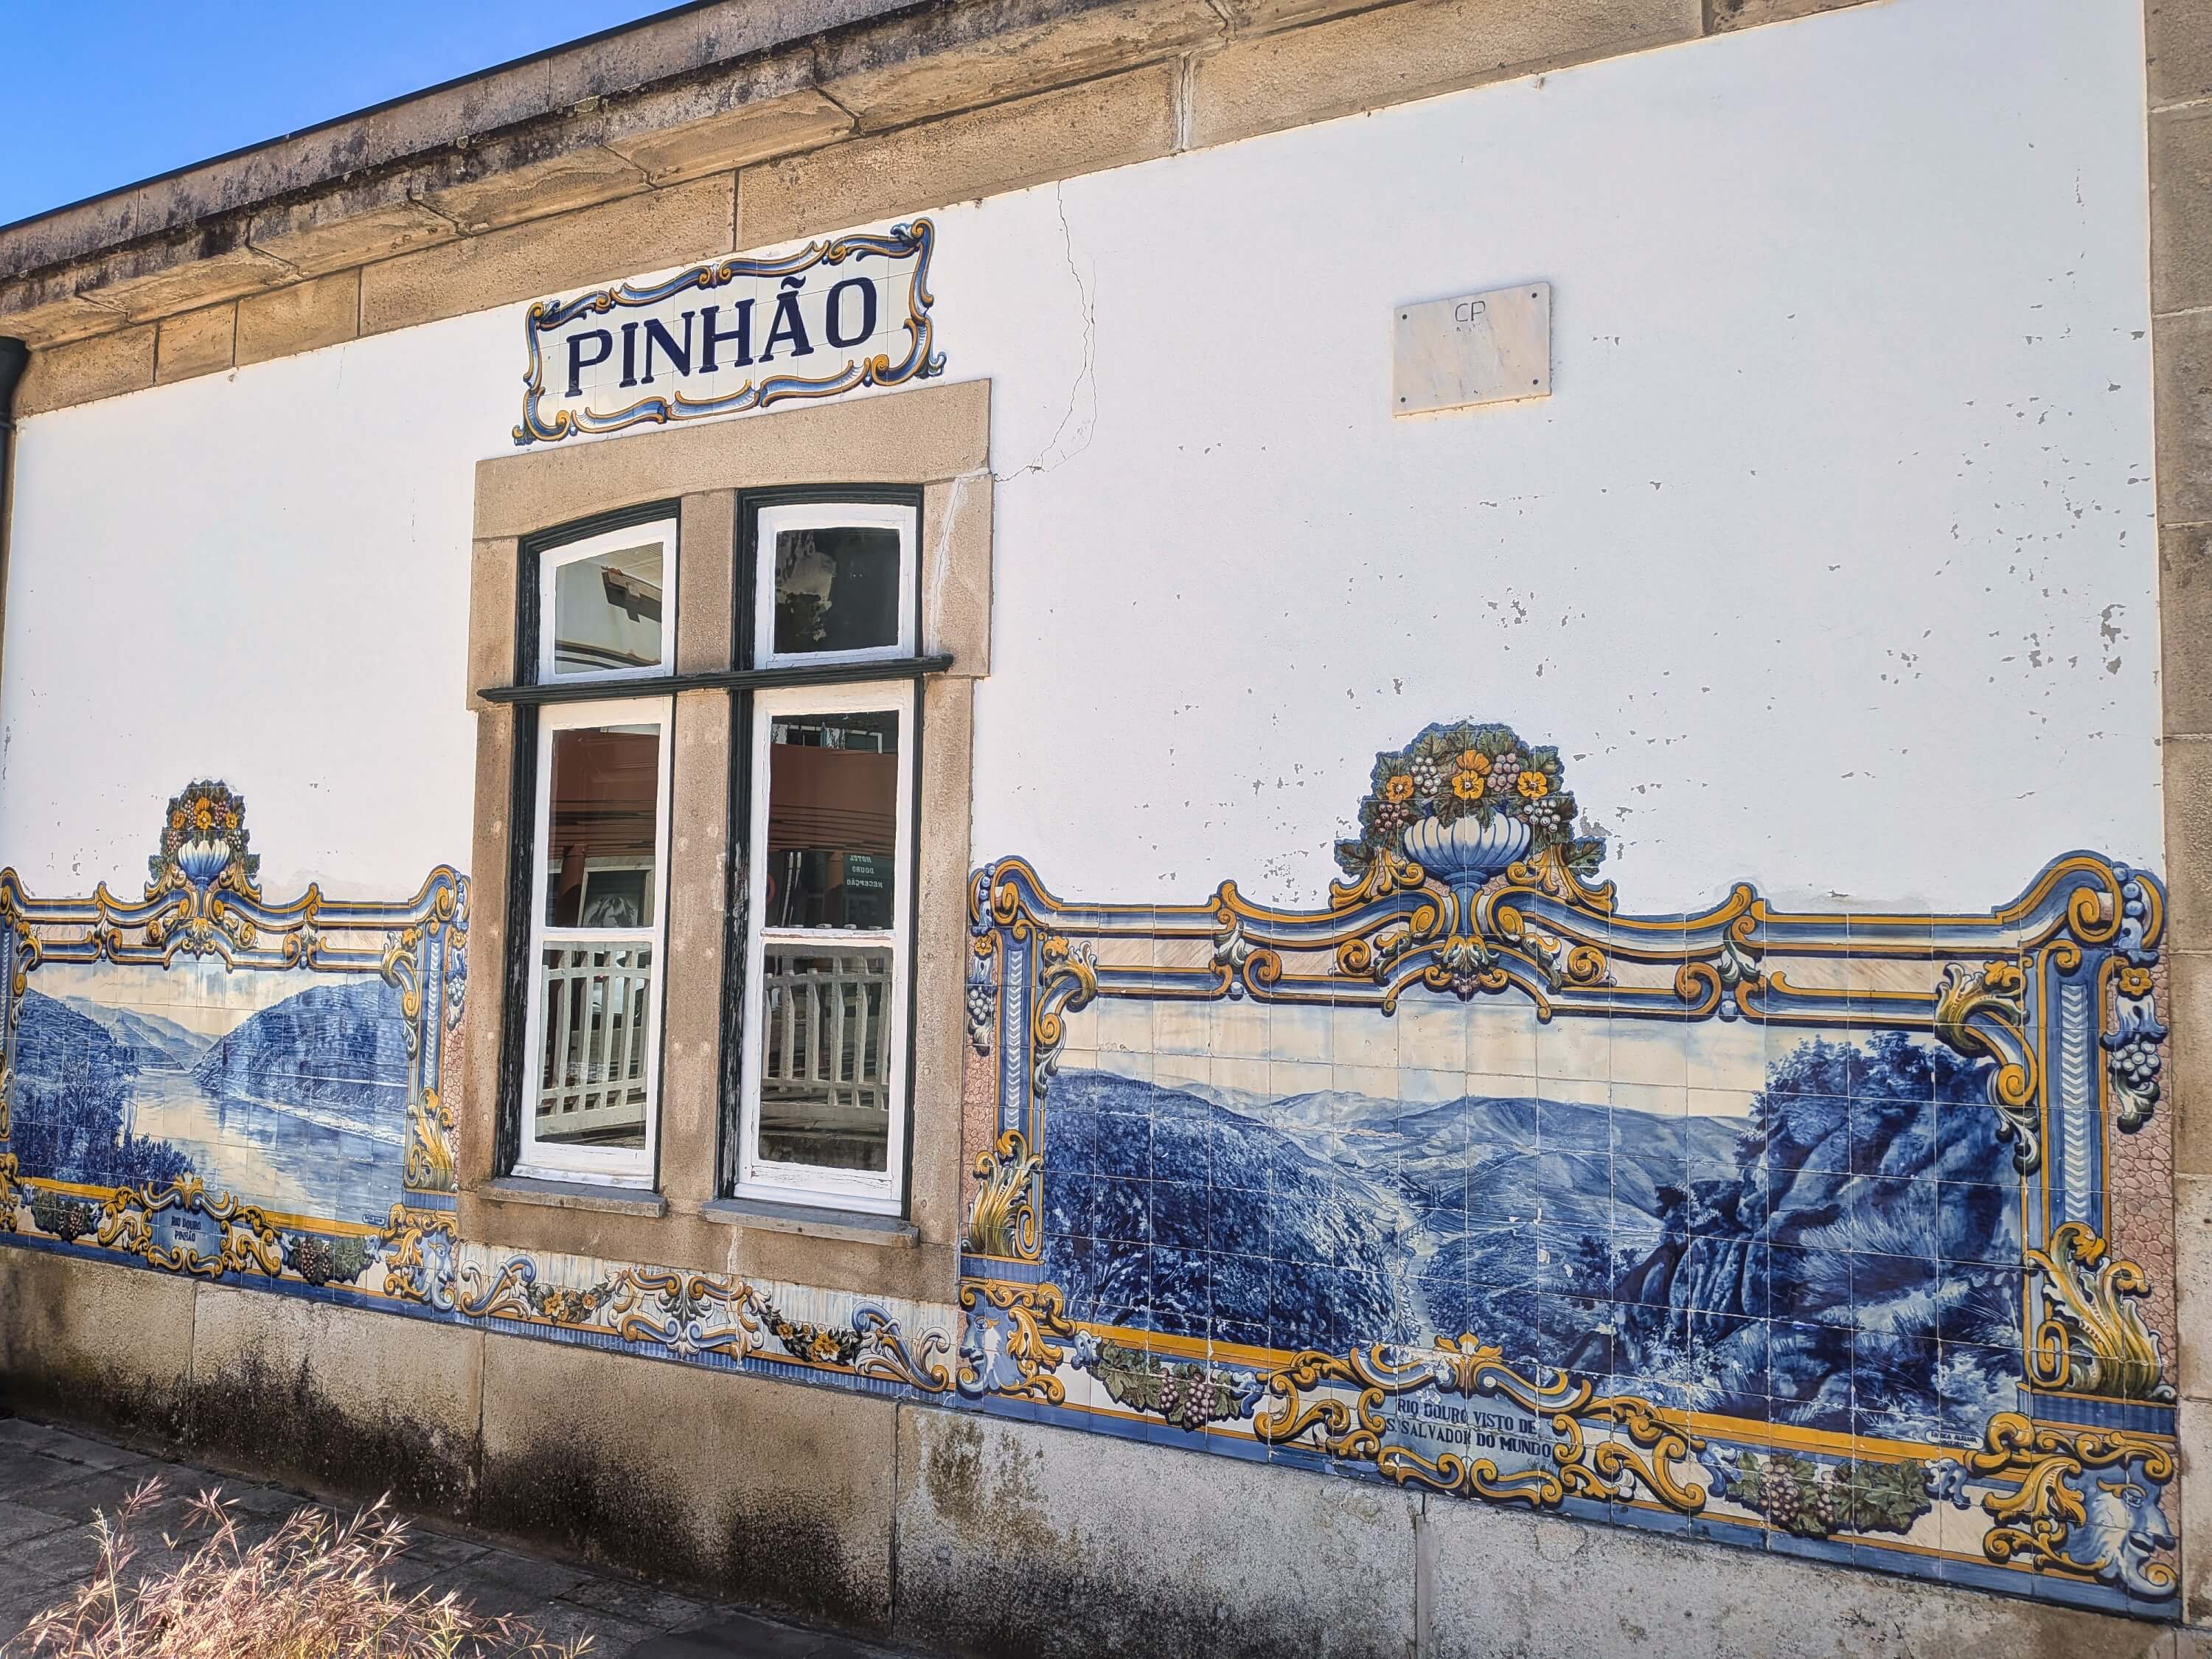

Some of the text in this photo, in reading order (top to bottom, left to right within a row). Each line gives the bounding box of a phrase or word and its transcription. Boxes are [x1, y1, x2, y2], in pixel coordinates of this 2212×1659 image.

[1455, 300, 1486, 321] CP
[564, 276, 878, 398] PINHÃO
[171, 1216, 201, 1230] RIO DOURO
[174, 1230, 195, 1242] PINHÃO
[1397, 1399, 1537, 1435] RIO DOURO VISTO DE
[1387, 1418, 1551, 1458] S. SALVADOR DO MUNDO
